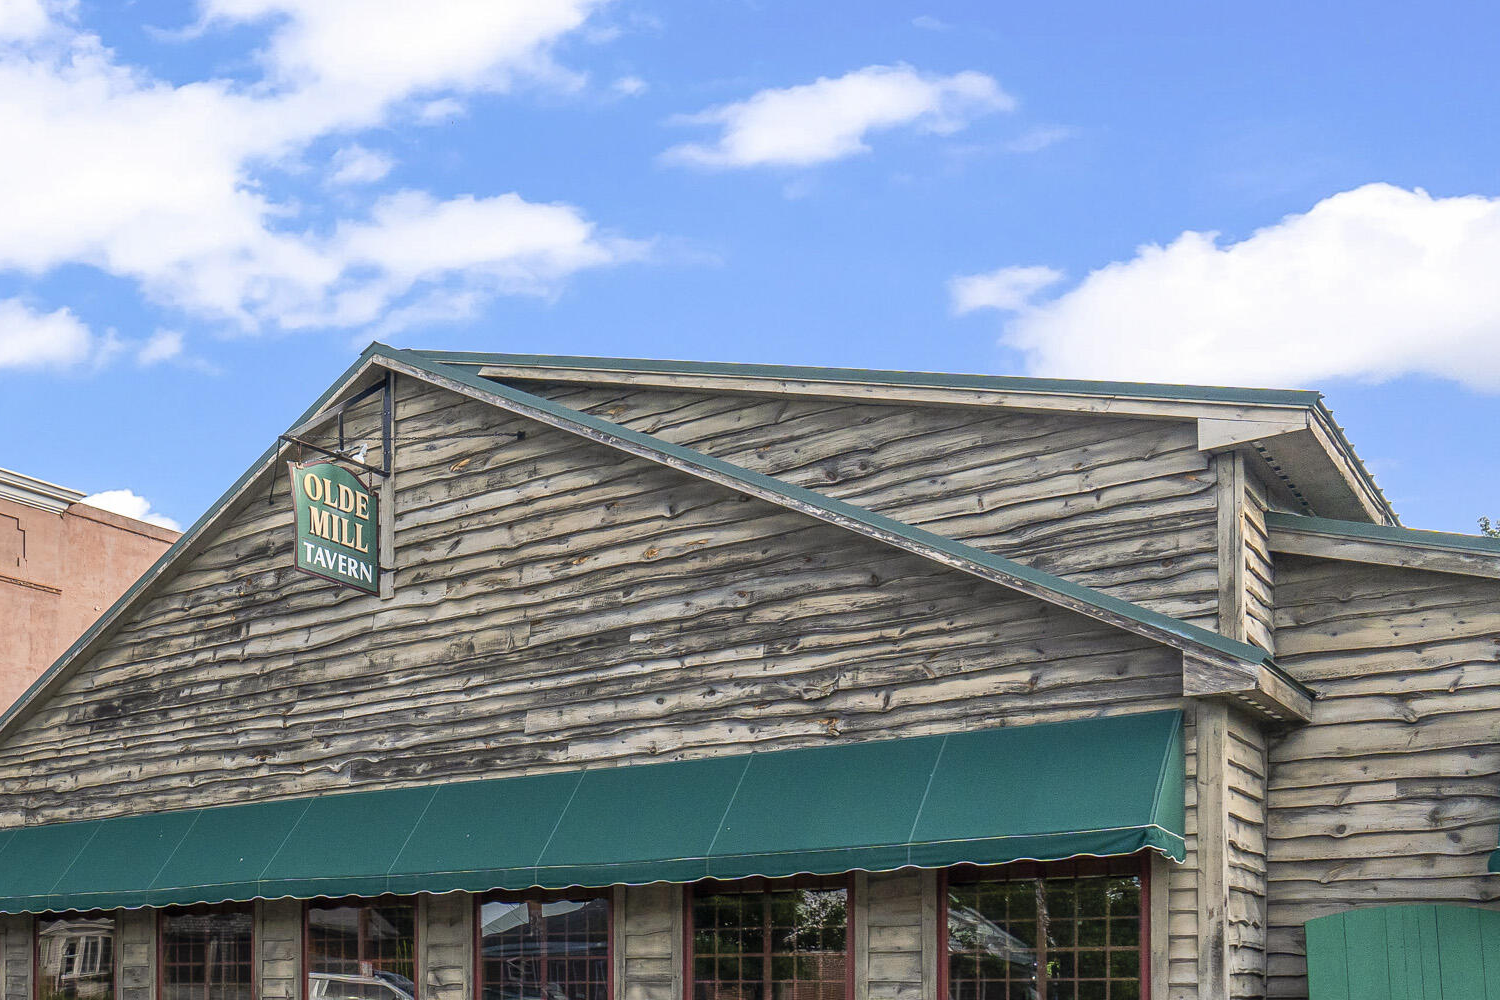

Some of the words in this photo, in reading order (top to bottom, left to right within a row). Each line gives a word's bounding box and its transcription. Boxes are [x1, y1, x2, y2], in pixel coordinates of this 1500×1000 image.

[303, 473, 370, 521] OLDE
[308, 505, 369, 554] MILL
[303, 541, 373, 584] TAVERN
